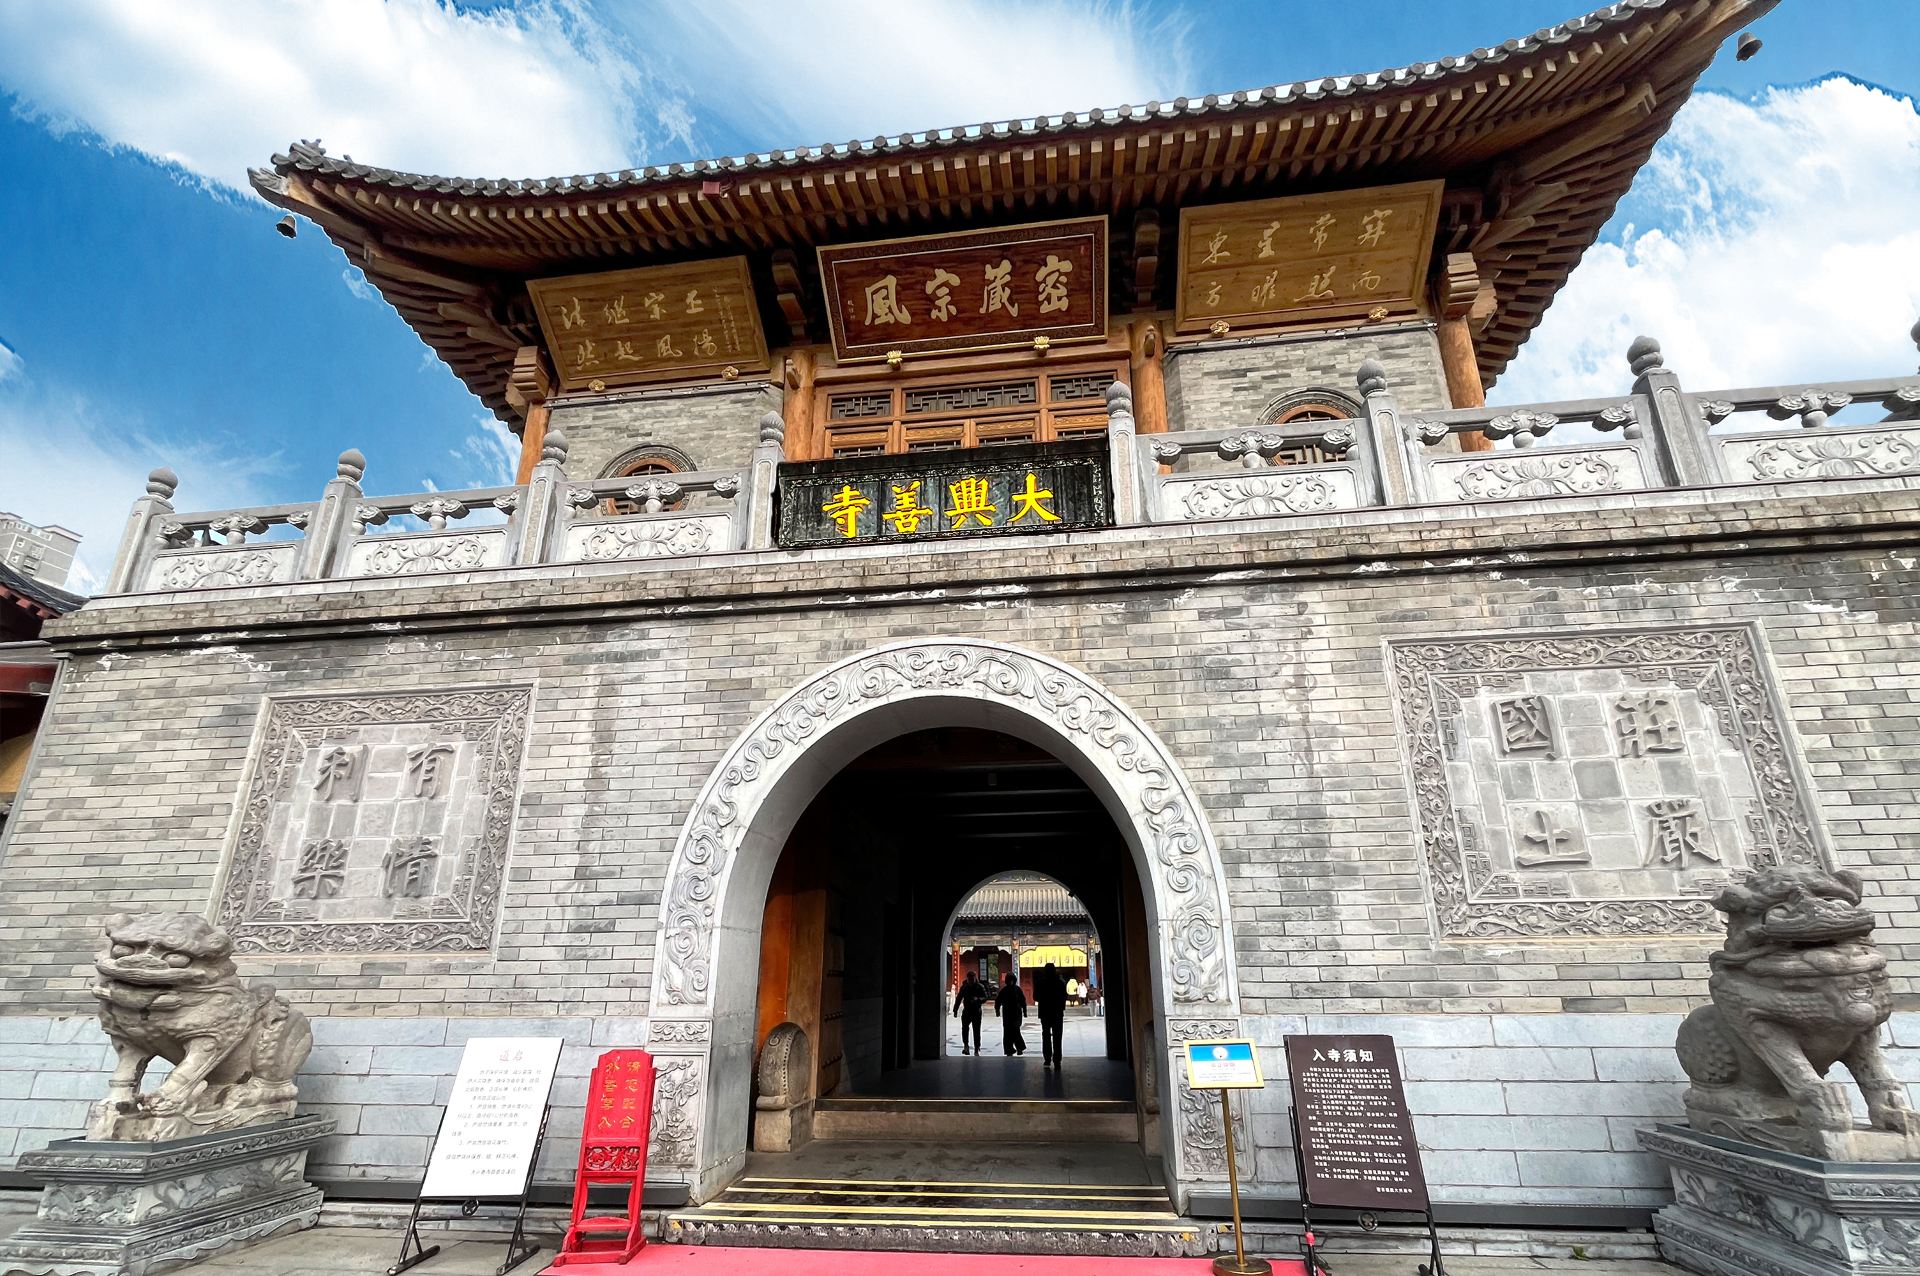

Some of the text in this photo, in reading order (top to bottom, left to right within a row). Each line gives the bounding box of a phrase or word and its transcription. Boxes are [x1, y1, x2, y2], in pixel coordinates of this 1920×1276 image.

[822, 473, 1062, 539] 大興善寺
[1312, 1048, 1374, 1063] 入寺须知
